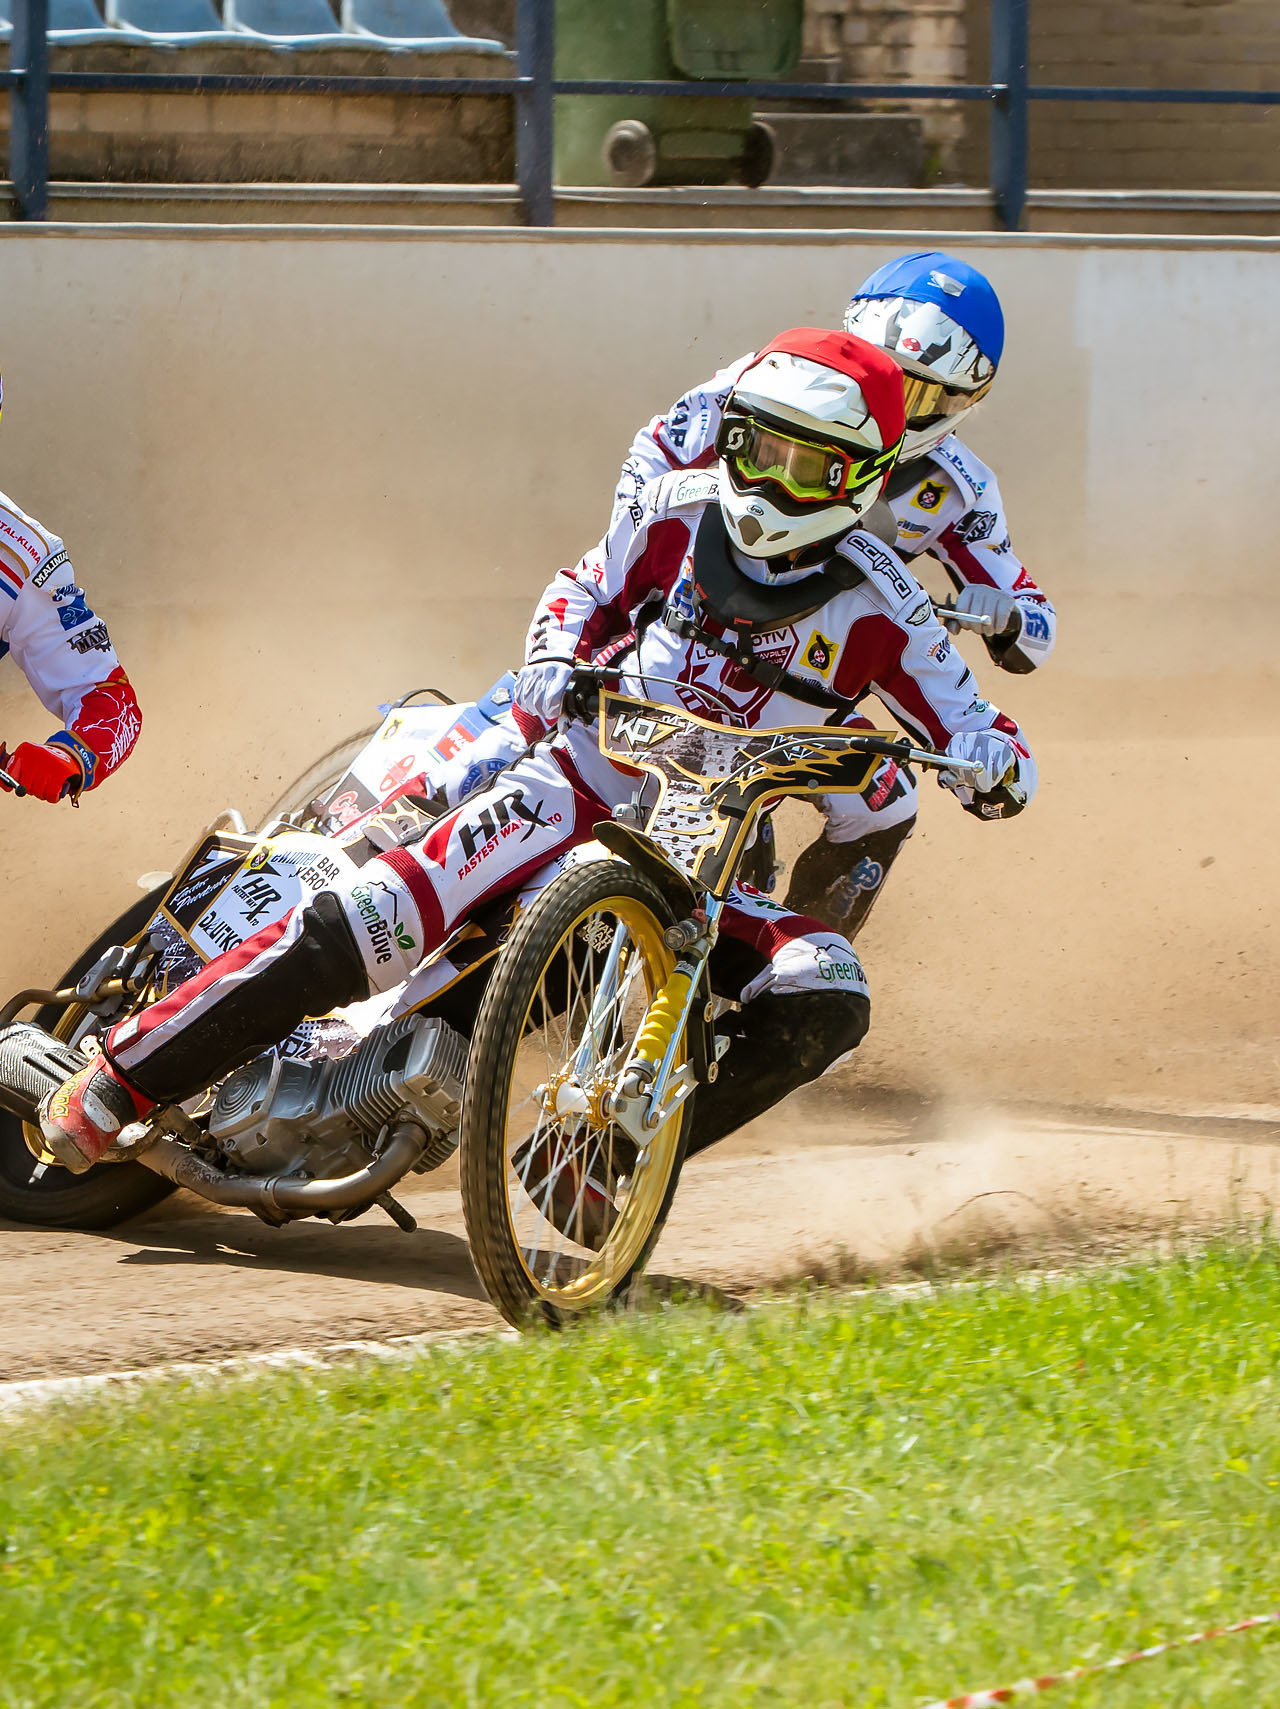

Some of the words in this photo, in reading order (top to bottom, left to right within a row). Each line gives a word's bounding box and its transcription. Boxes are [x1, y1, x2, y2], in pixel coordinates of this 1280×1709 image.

[695, 629, 788, 661] LOOTIV
[457, 834, 501, 881] FASTEST
[499, 818, 525, 839] WAY
[547, 812, 563, 826] TO
[316, 856, 341, 881] BAR
